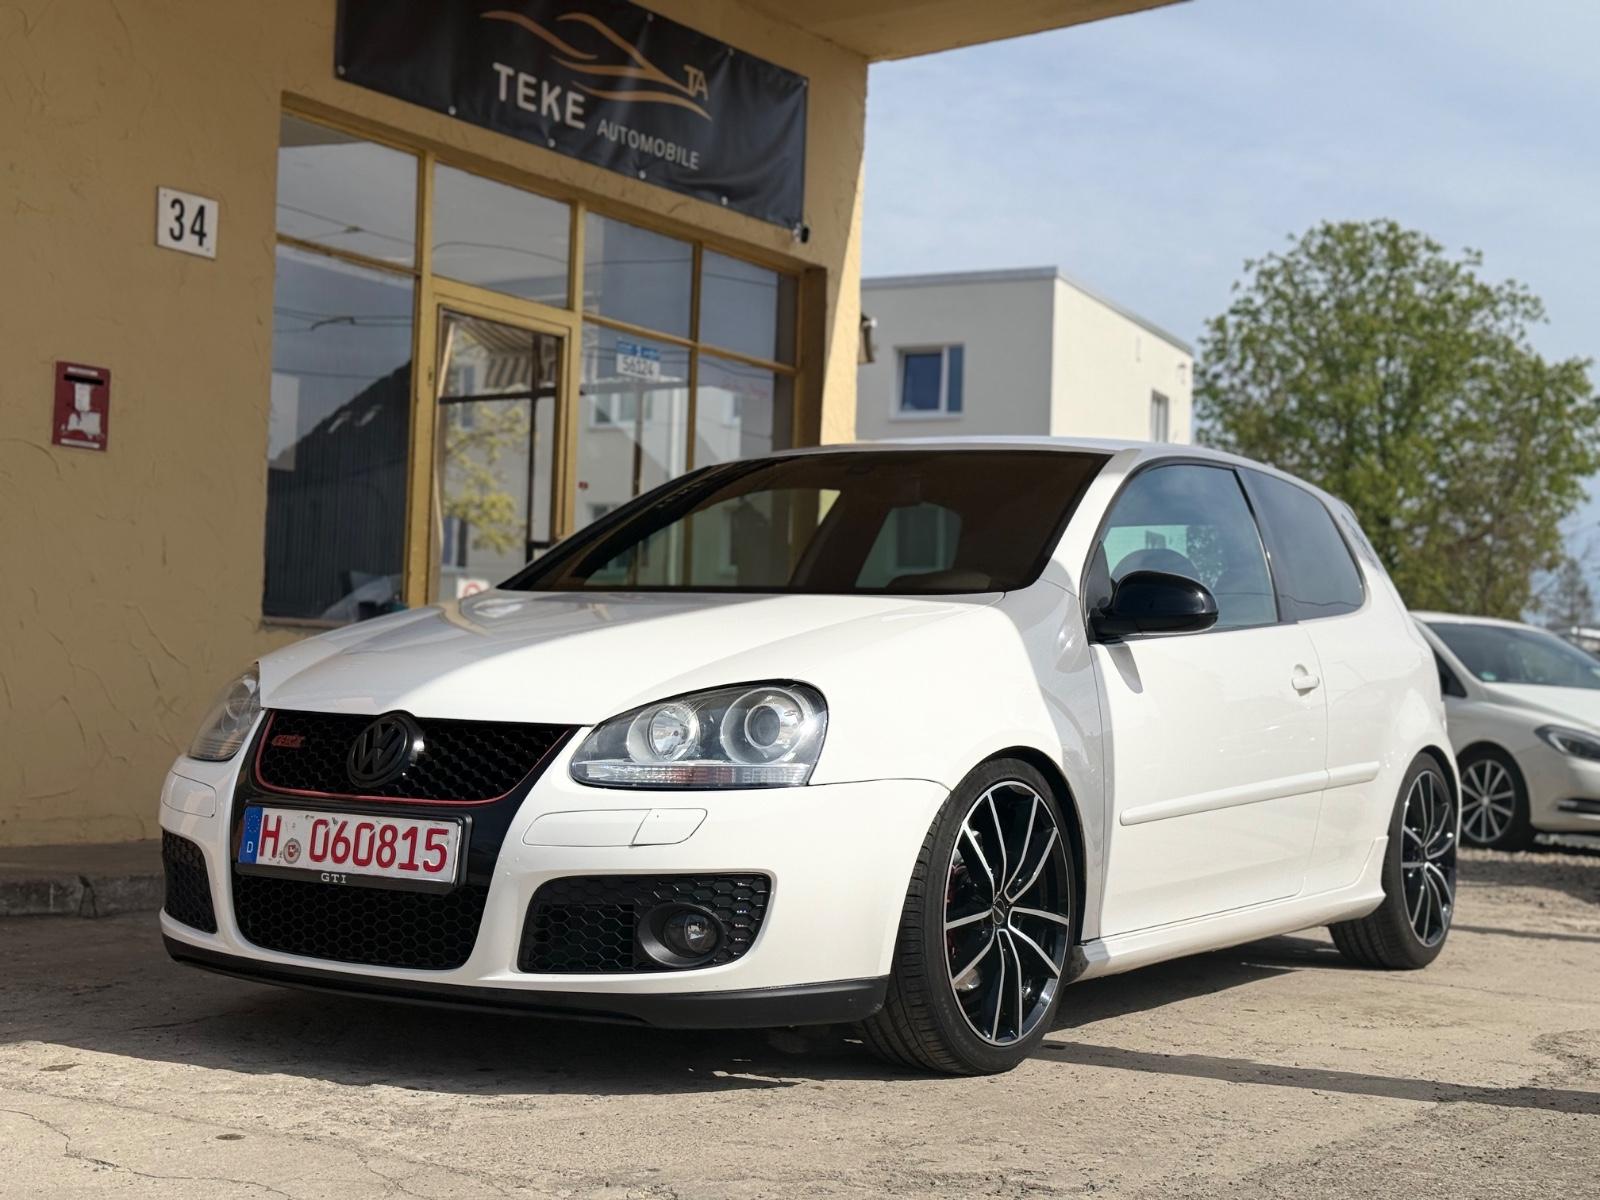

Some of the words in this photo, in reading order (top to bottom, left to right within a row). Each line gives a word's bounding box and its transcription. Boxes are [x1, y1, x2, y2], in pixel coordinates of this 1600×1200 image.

[683, 64, 709, 100] TA
[493, 62, 586, 129] TEKE
[597, 118, 700, 170] AUTOMOBILE
[169, 198, 207, 247] 34
[246, 841, 254, 854] D
[309, 818, 450, 873] 060815
[320, 872, 347, 884] GTI
